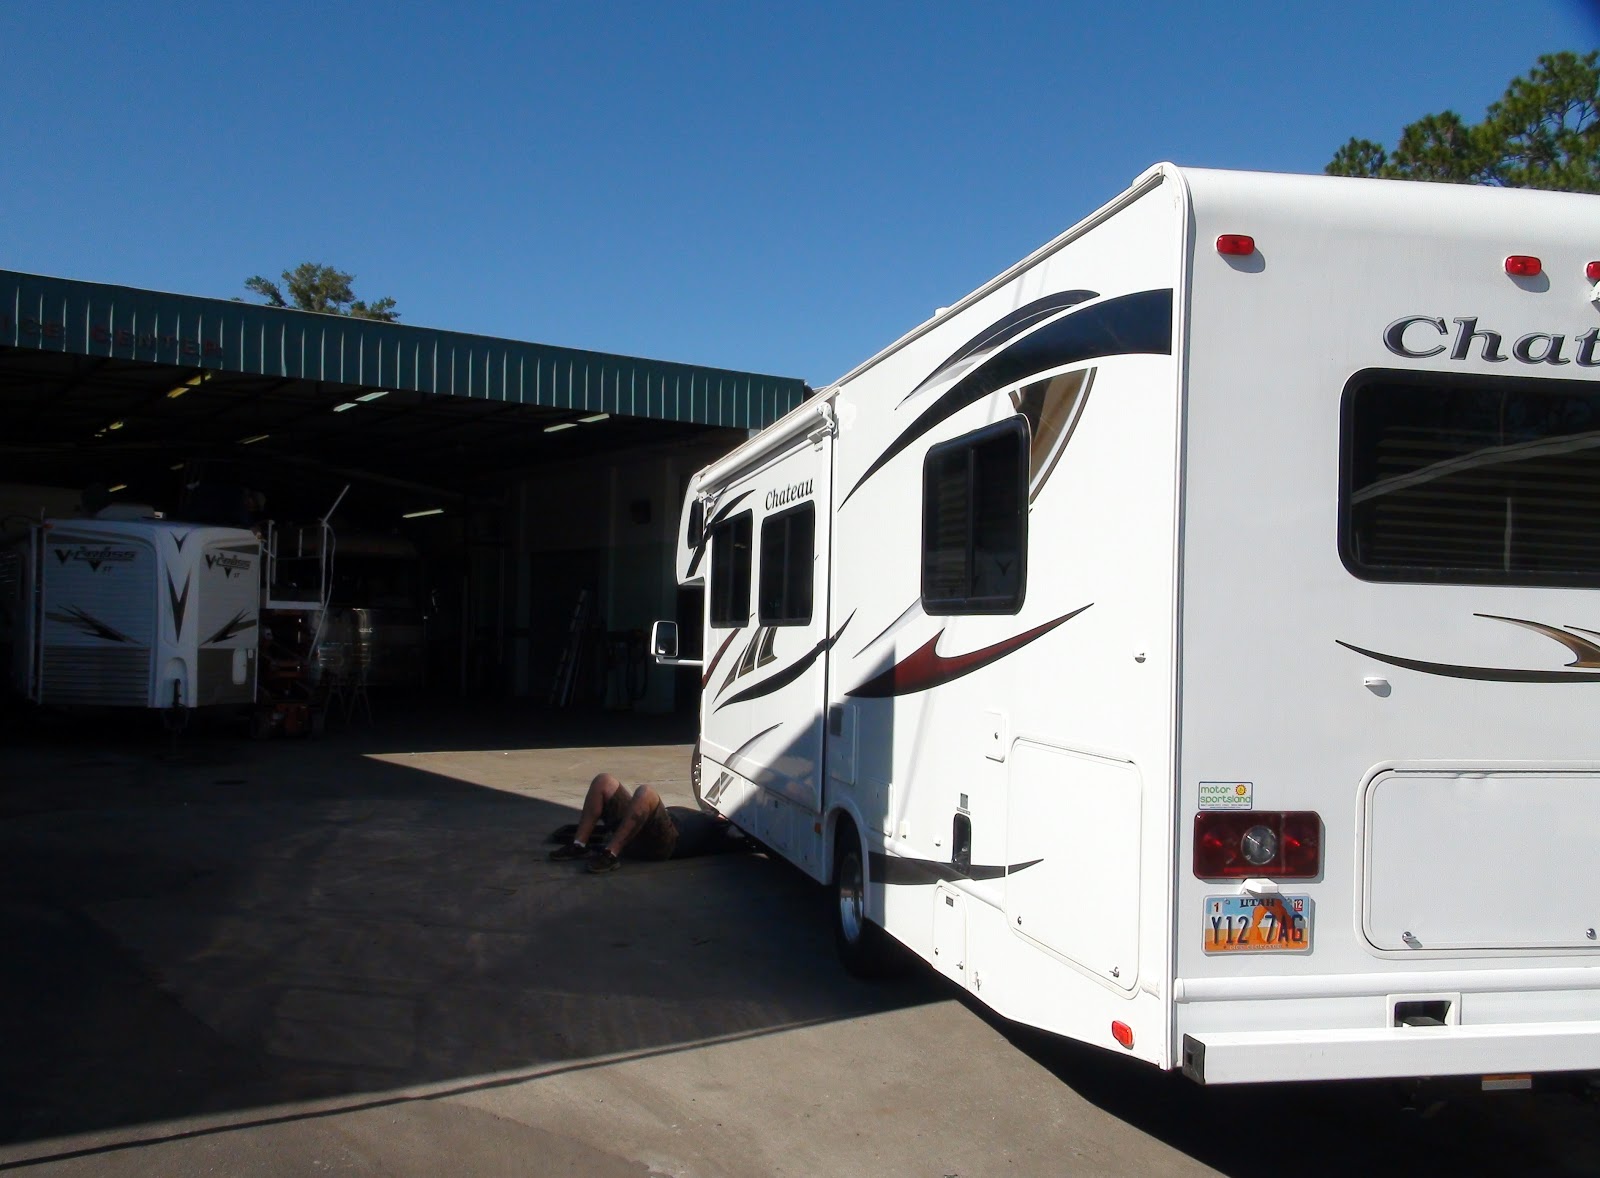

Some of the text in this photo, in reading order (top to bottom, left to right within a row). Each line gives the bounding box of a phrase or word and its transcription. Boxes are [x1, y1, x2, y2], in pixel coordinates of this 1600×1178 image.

[91, 324, 221, 353] CENTER
[765, 477, 814, 511] Chateau
[1200, 795, 1251, 804] sportsland
[1201, 786, 1231, 794] motor
[1240, 898, 1276, 908] UTAH
[1294, 900, 1304, 909] 12
[1211, 913, 1304, 944] Y12 7AG
